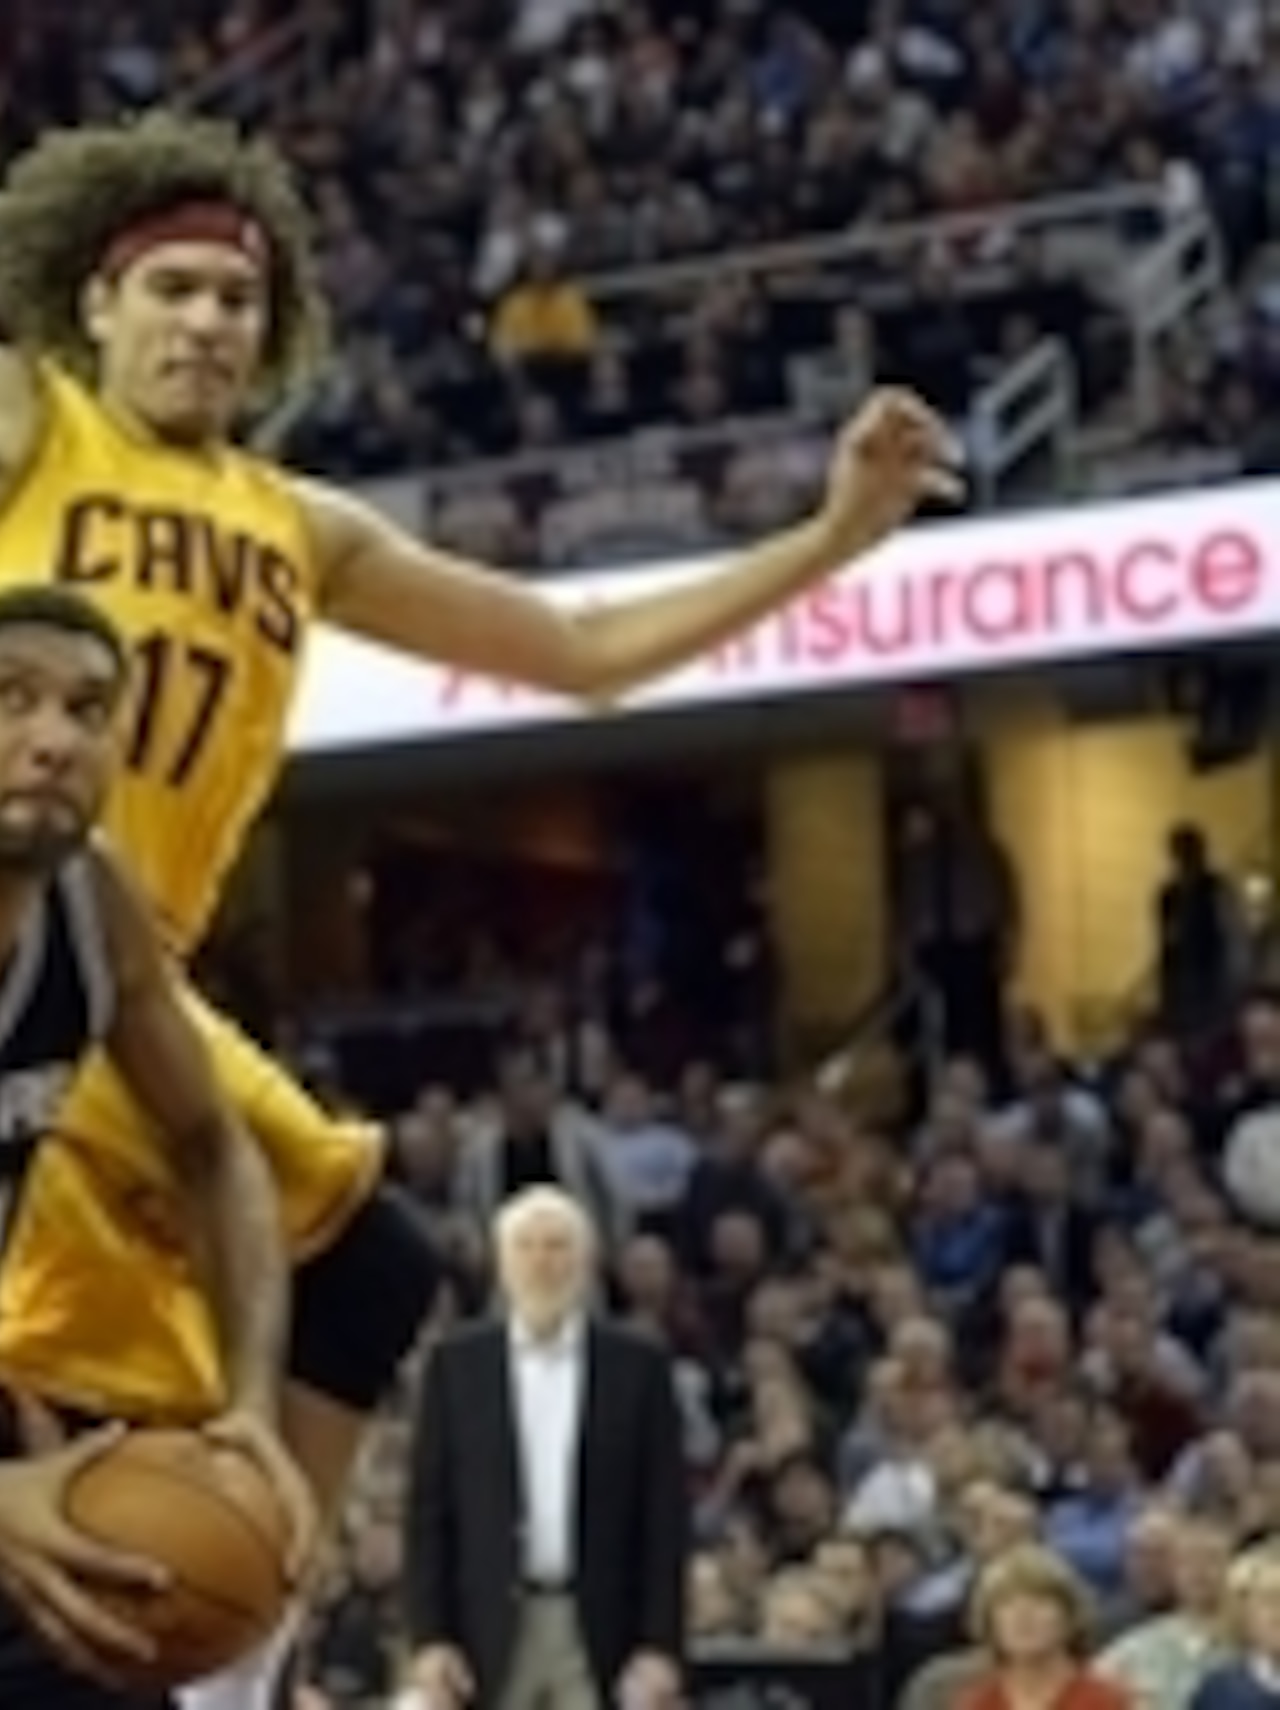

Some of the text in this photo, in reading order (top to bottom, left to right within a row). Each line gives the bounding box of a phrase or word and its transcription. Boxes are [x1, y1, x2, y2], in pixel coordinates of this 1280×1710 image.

[57, 494, 299, 654] CAVS
[712, 528, 1262, 675] nsurance
[126, 631, 230, 789] 17
